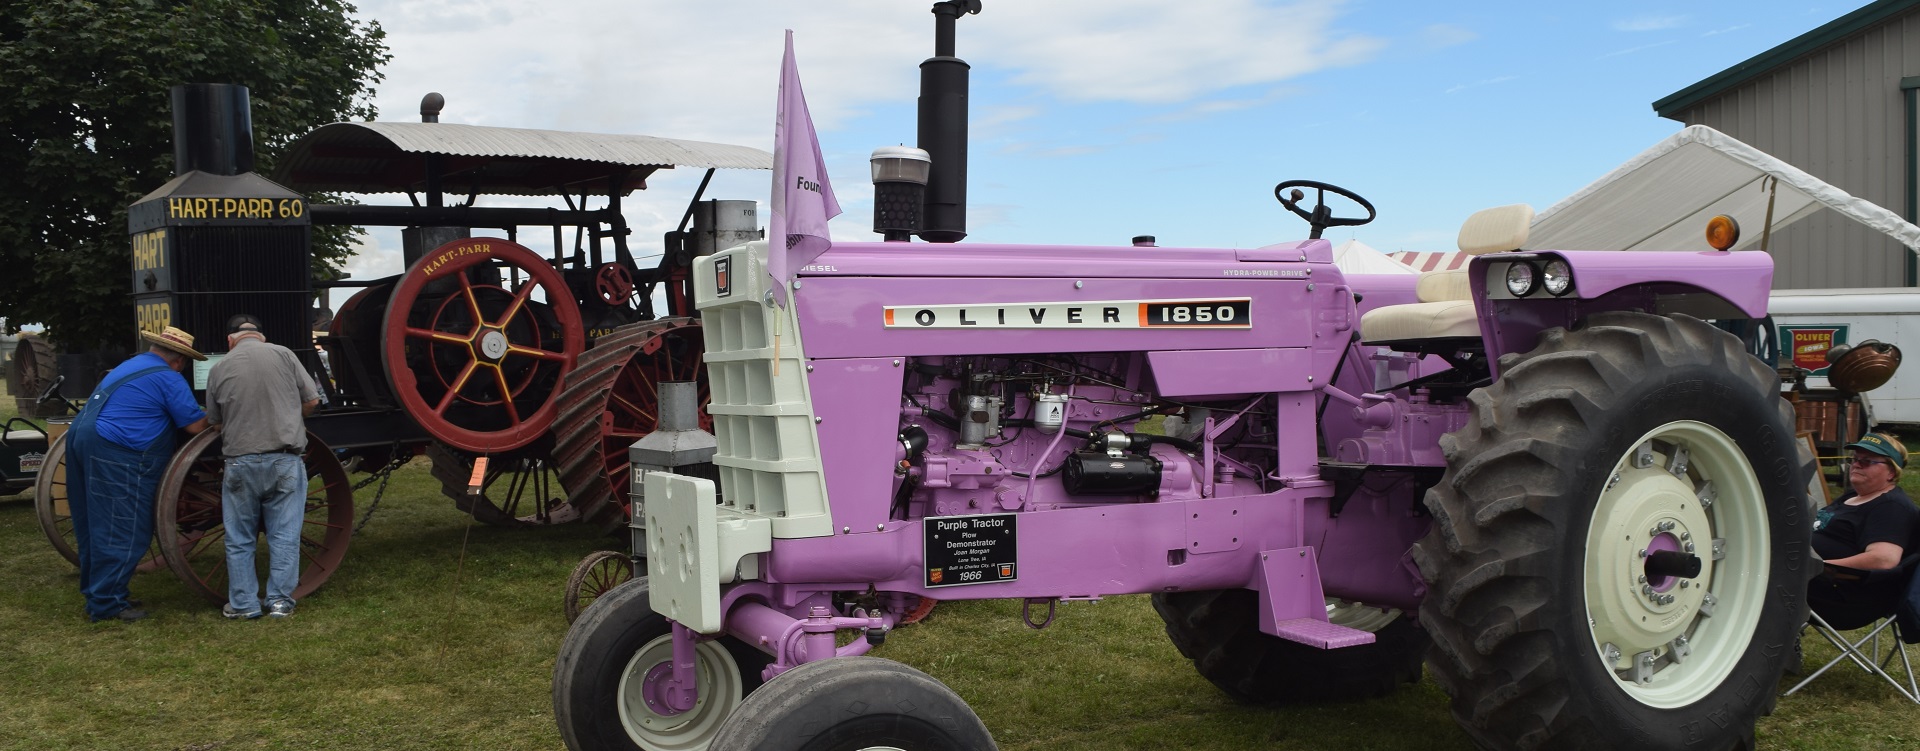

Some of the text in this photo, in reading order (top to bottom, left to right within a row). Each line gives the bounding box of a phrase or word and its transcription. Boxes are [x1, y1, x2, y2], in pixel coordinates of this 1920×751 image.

[169, 197, 303, 219] HART-PARR 60
[133, 230, 166, 271] HART
[422, 244, 491, 276] HART-PARR
[914, 306, 1235, 326] OLIVER 1850
[1795, 333, 1831, 341] OLIVER
[1804, 343, 1824, 352] IOWA
[937, 519, 1004, 531] Purple Tractor
[946, 539, 996, 549] Demonstrator
[959, 571, 982, 581] 1966
